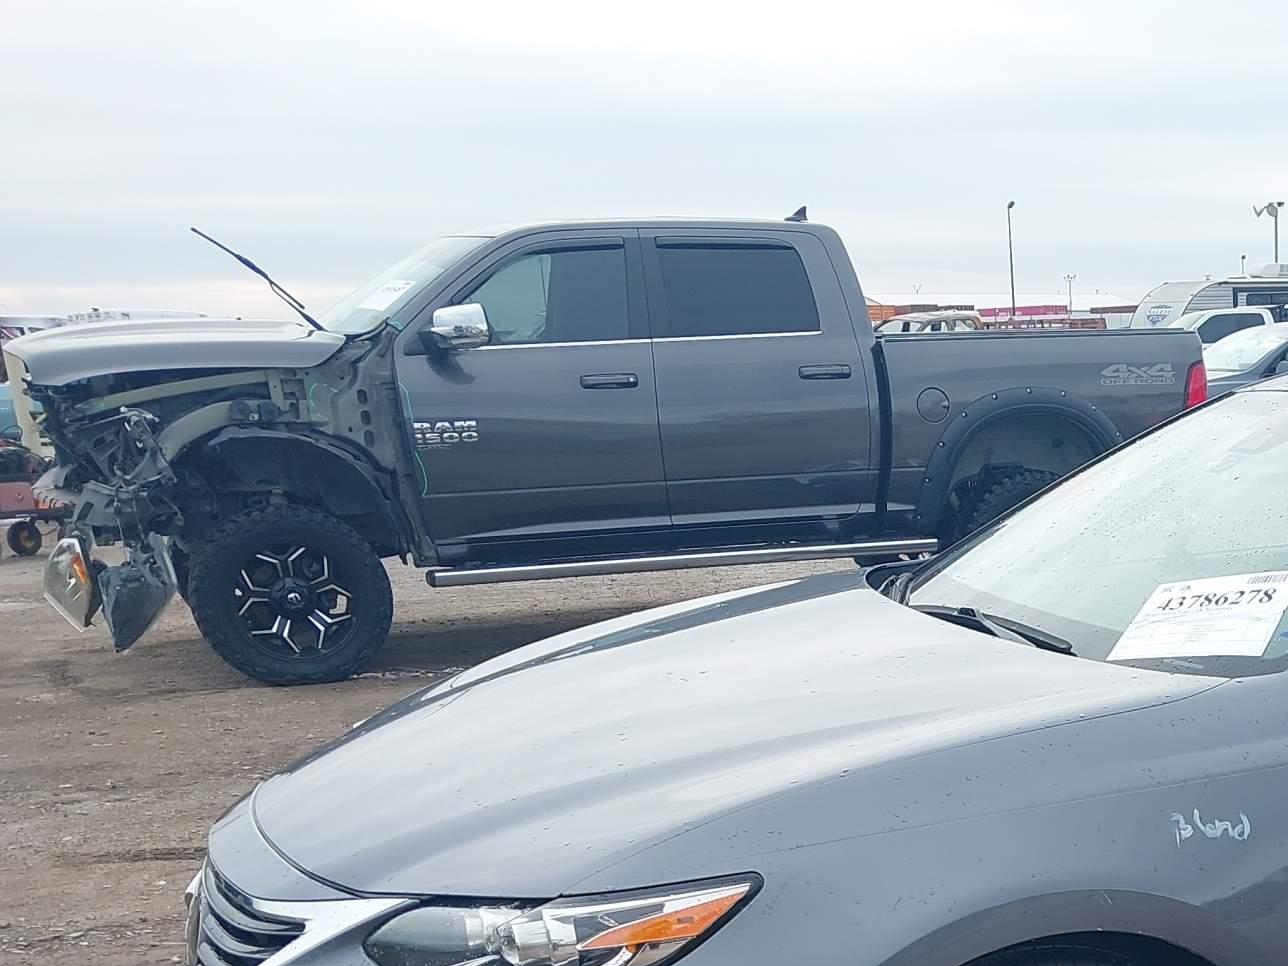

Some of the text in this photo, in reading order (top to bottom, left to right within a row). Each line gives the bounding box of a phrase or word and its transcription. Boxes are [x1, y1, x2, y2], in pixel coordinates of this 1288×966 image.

[413, 420, 477, 433] RAM
[414, 431, 479, 444] 1500
[1157, 588, 1277, 611] 43786278
